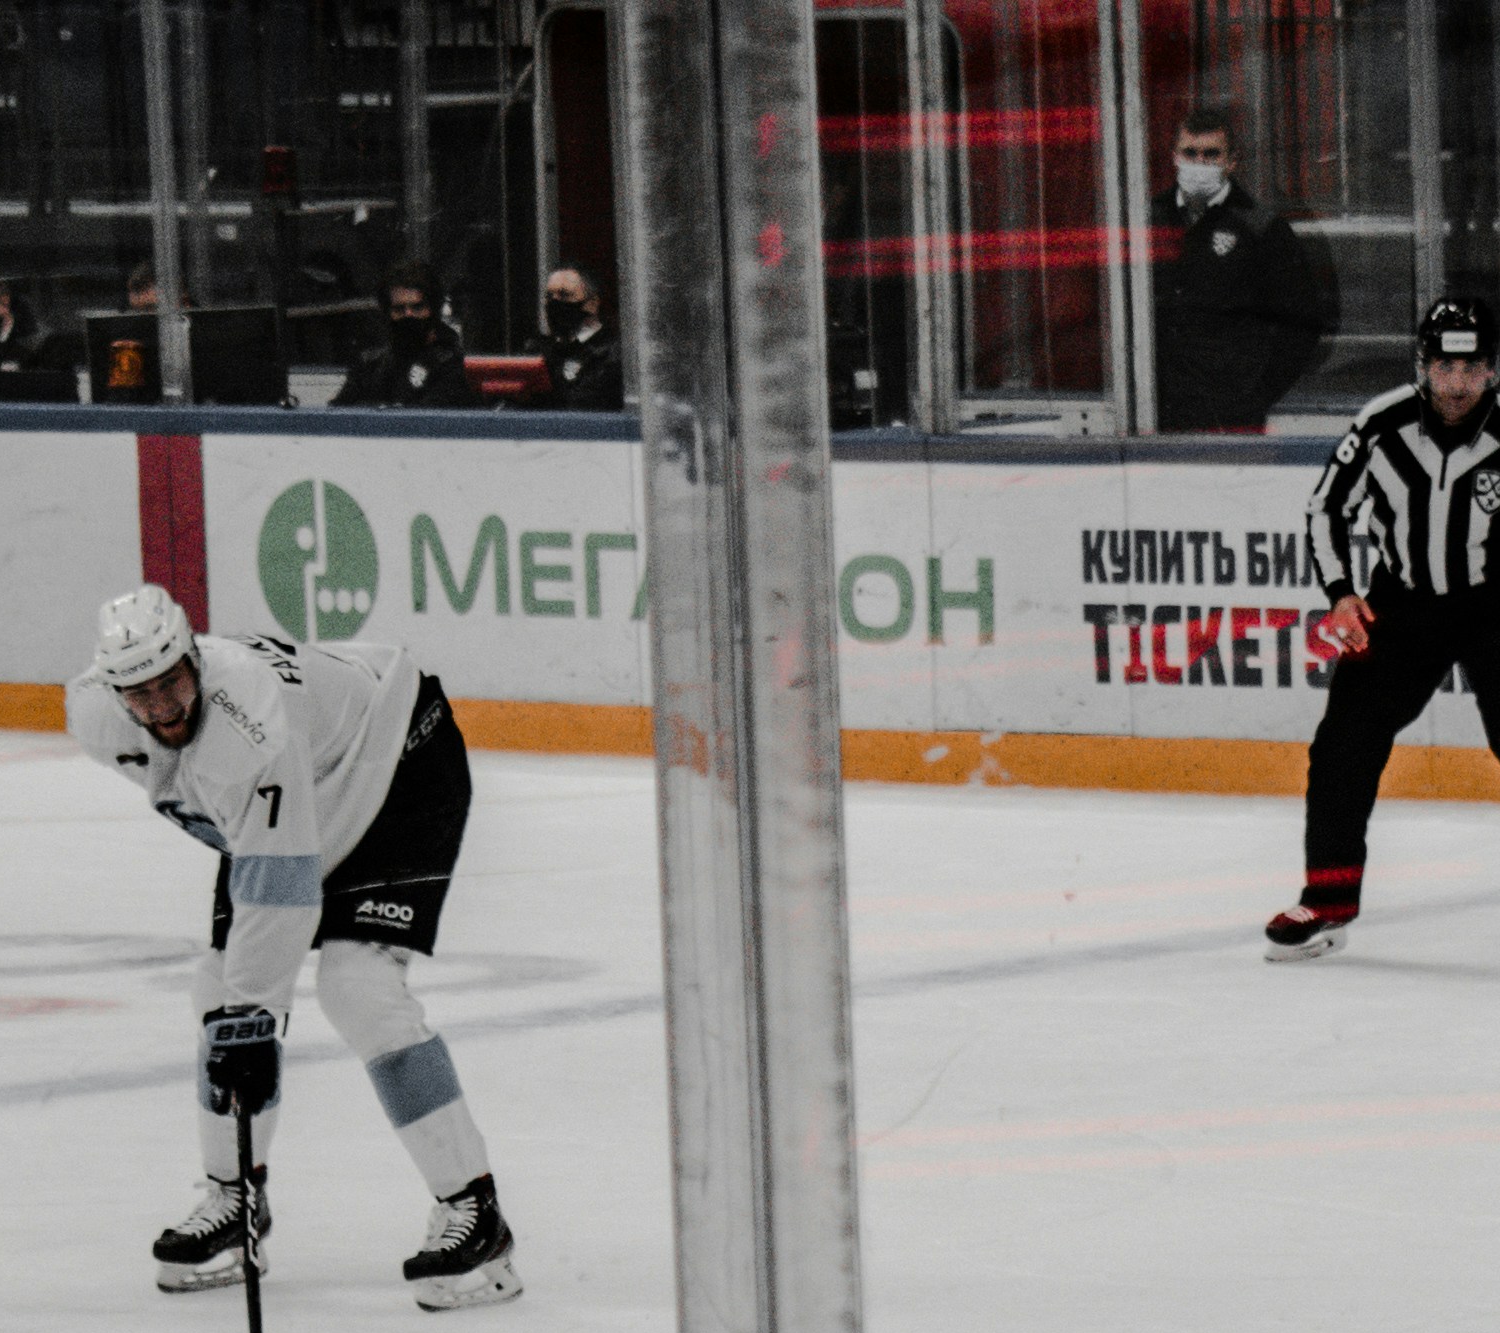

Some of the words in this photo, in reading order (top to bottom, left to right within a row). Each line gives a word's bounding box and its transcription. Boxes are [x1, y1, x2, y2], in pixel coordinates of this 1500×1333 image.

[409, 513, 996, 646] МЕГОН
[1081, 529, 1236, 586] КУПИТЬ
[209, 688, 267, 745] Belavia
[257, 785, 282, 828] 7
